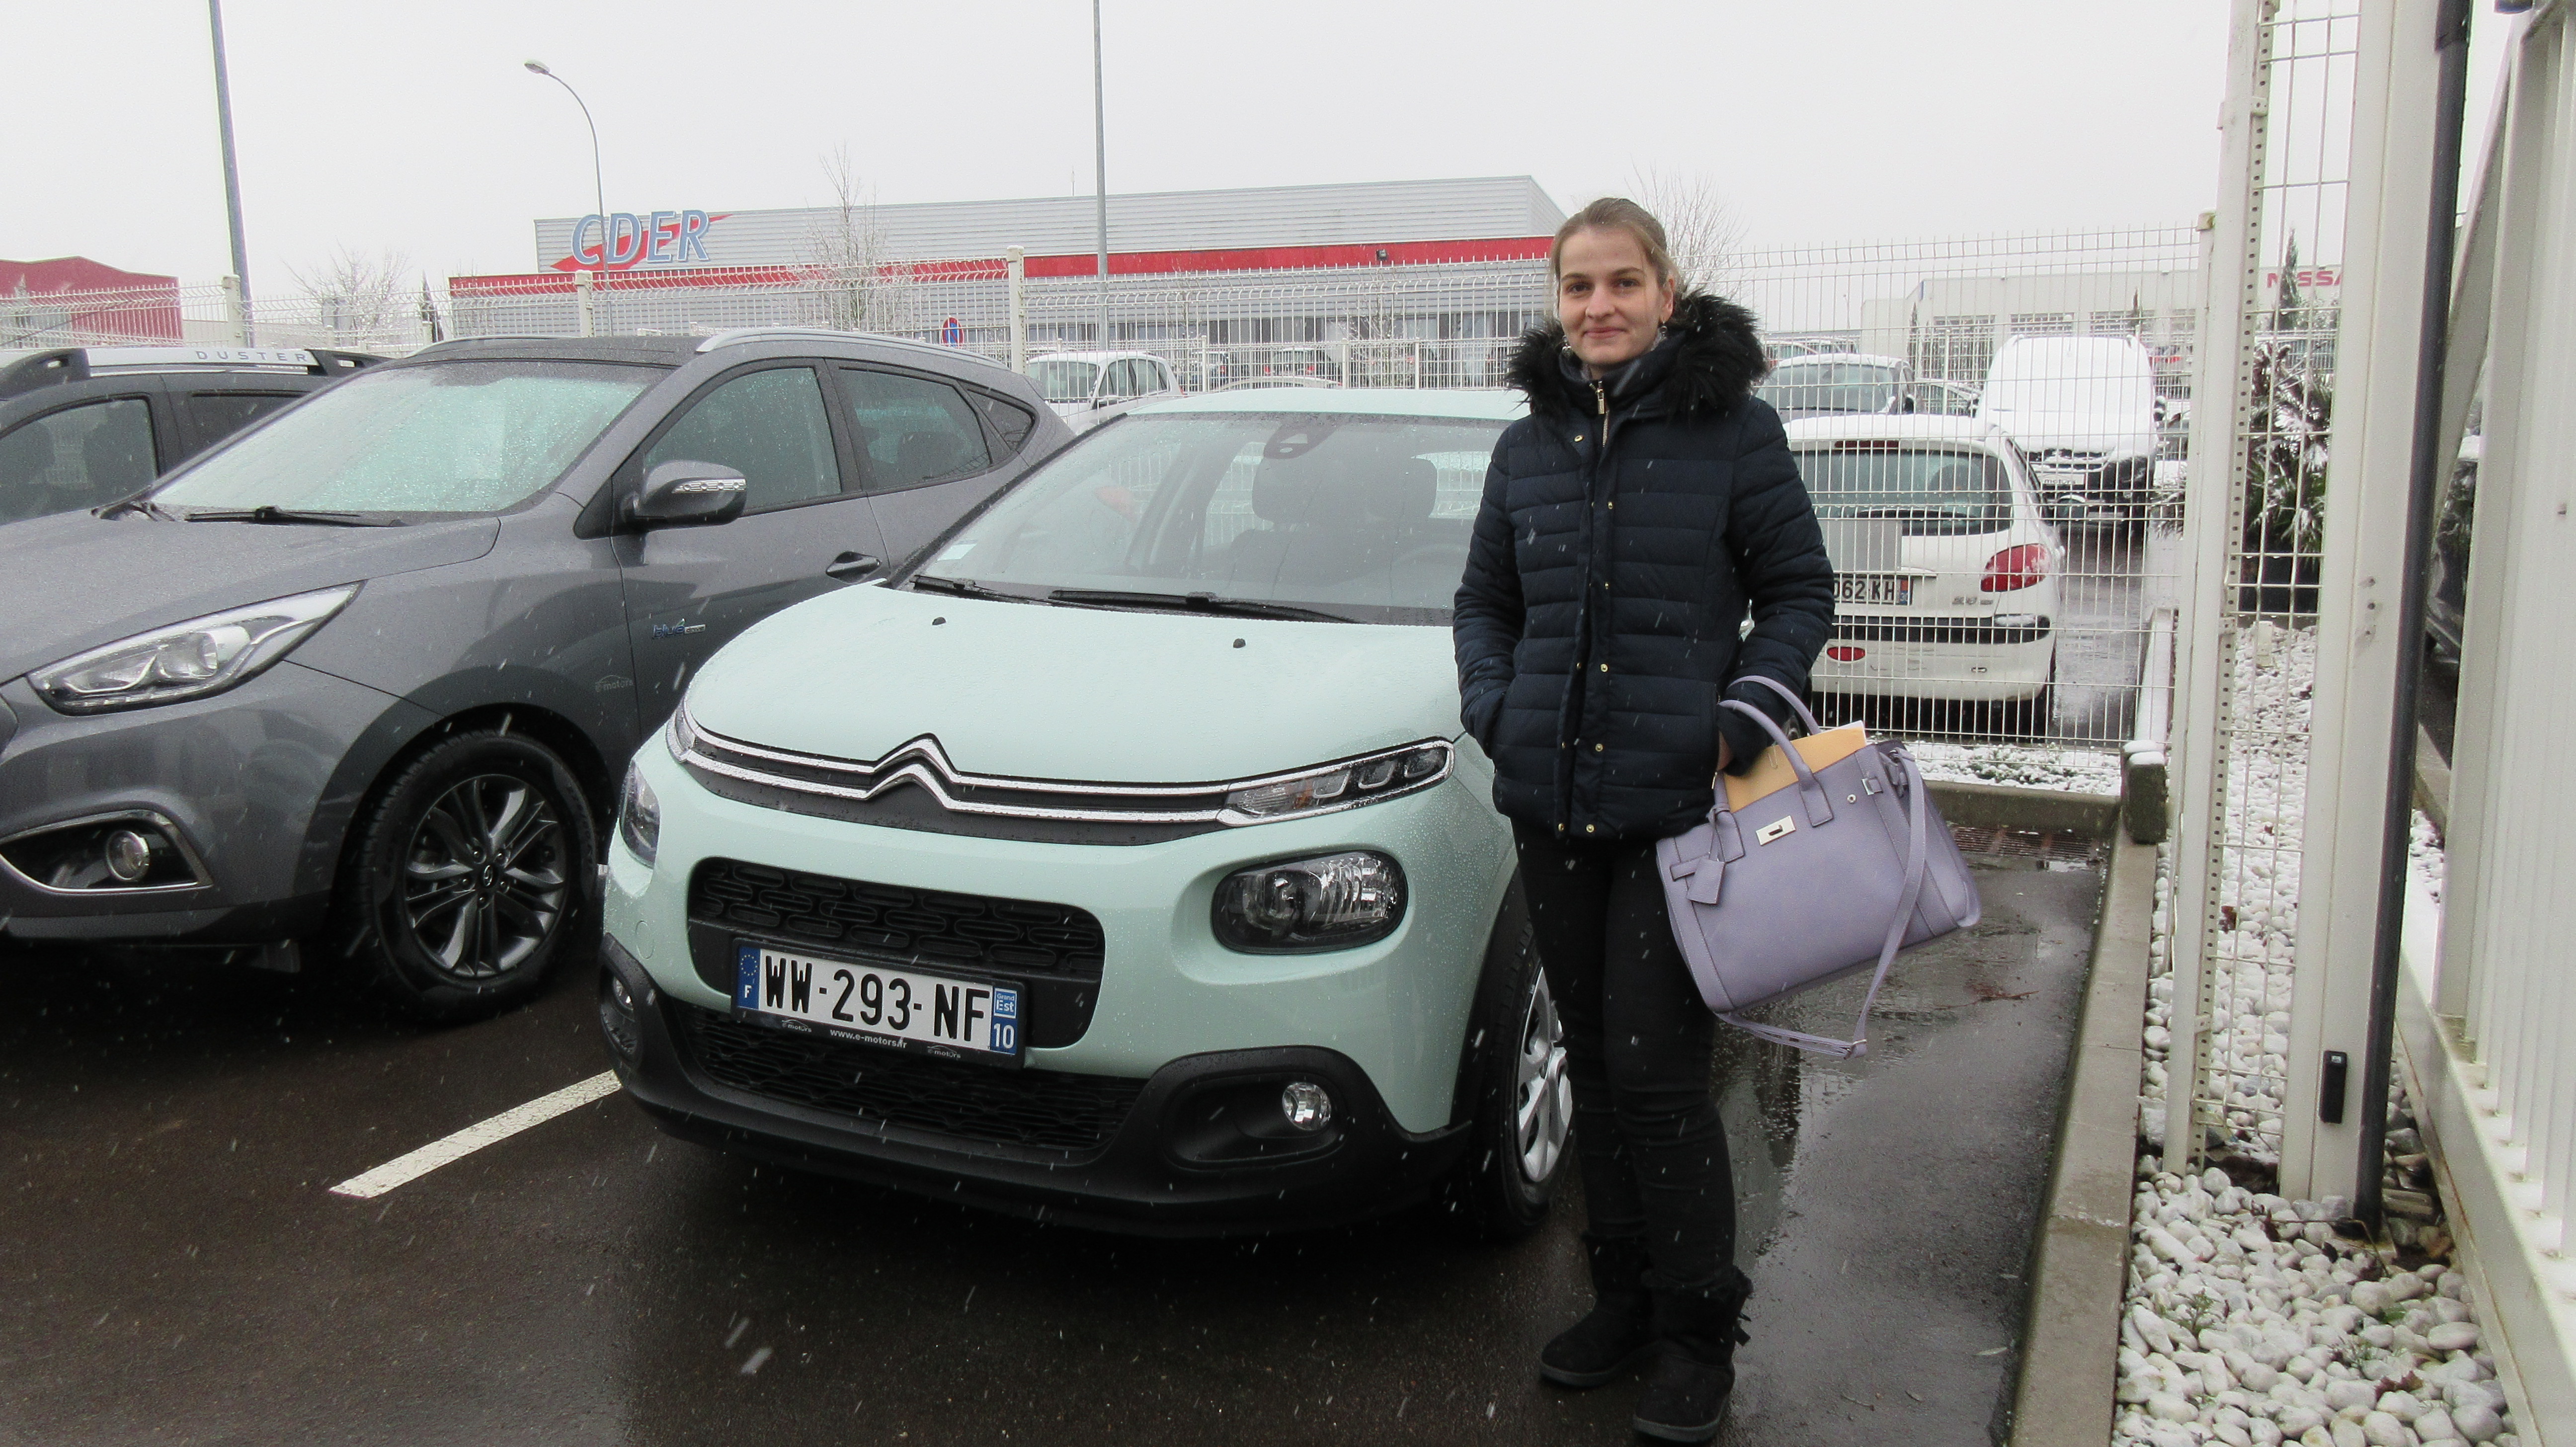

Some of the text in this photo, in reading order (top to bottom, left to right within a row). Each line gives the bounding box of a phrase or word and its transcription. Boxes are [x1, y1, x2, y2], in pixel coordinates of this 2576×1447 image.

[571, 209, 710, 265] CDER
[2267, 270, 2341, 288] NSS
[195, 350, 308, 362] DUSTER
[744, 984, 752, 998] F
[996, 993, 1015, 1001] Grand
[996, 999, 1015, 1013] Est
[993, 1023, 1015, 1049] 10
